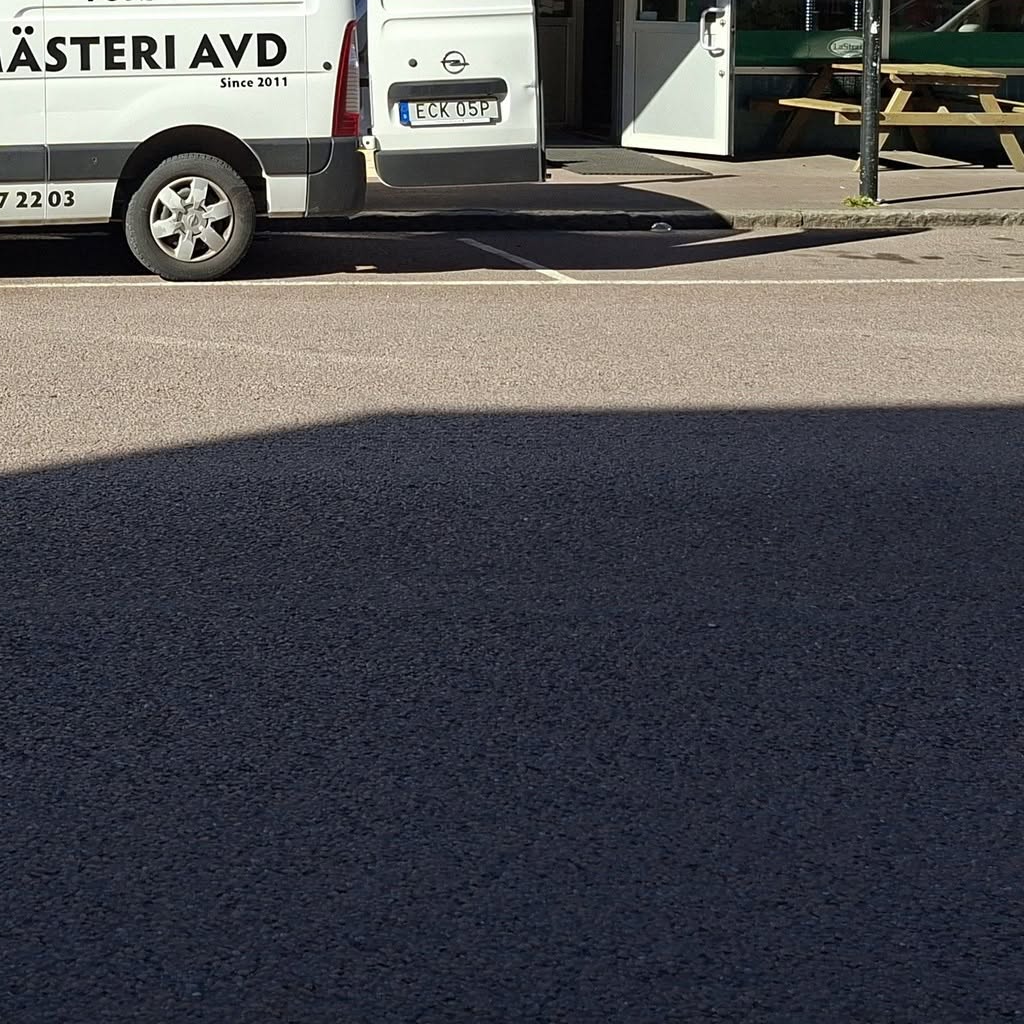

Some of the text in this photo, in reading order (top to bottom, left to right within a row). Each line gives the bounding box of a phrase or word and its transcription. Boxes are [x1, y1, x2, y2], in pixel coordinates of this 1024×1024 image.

[189, 33, 287, 69] AVD
[220, 77, 288, 89] Since 2011
[416, 101, 489, 119] ECK 05P
[16, 191, 43, 208] 22
[48, 190, 75, 207] 03
